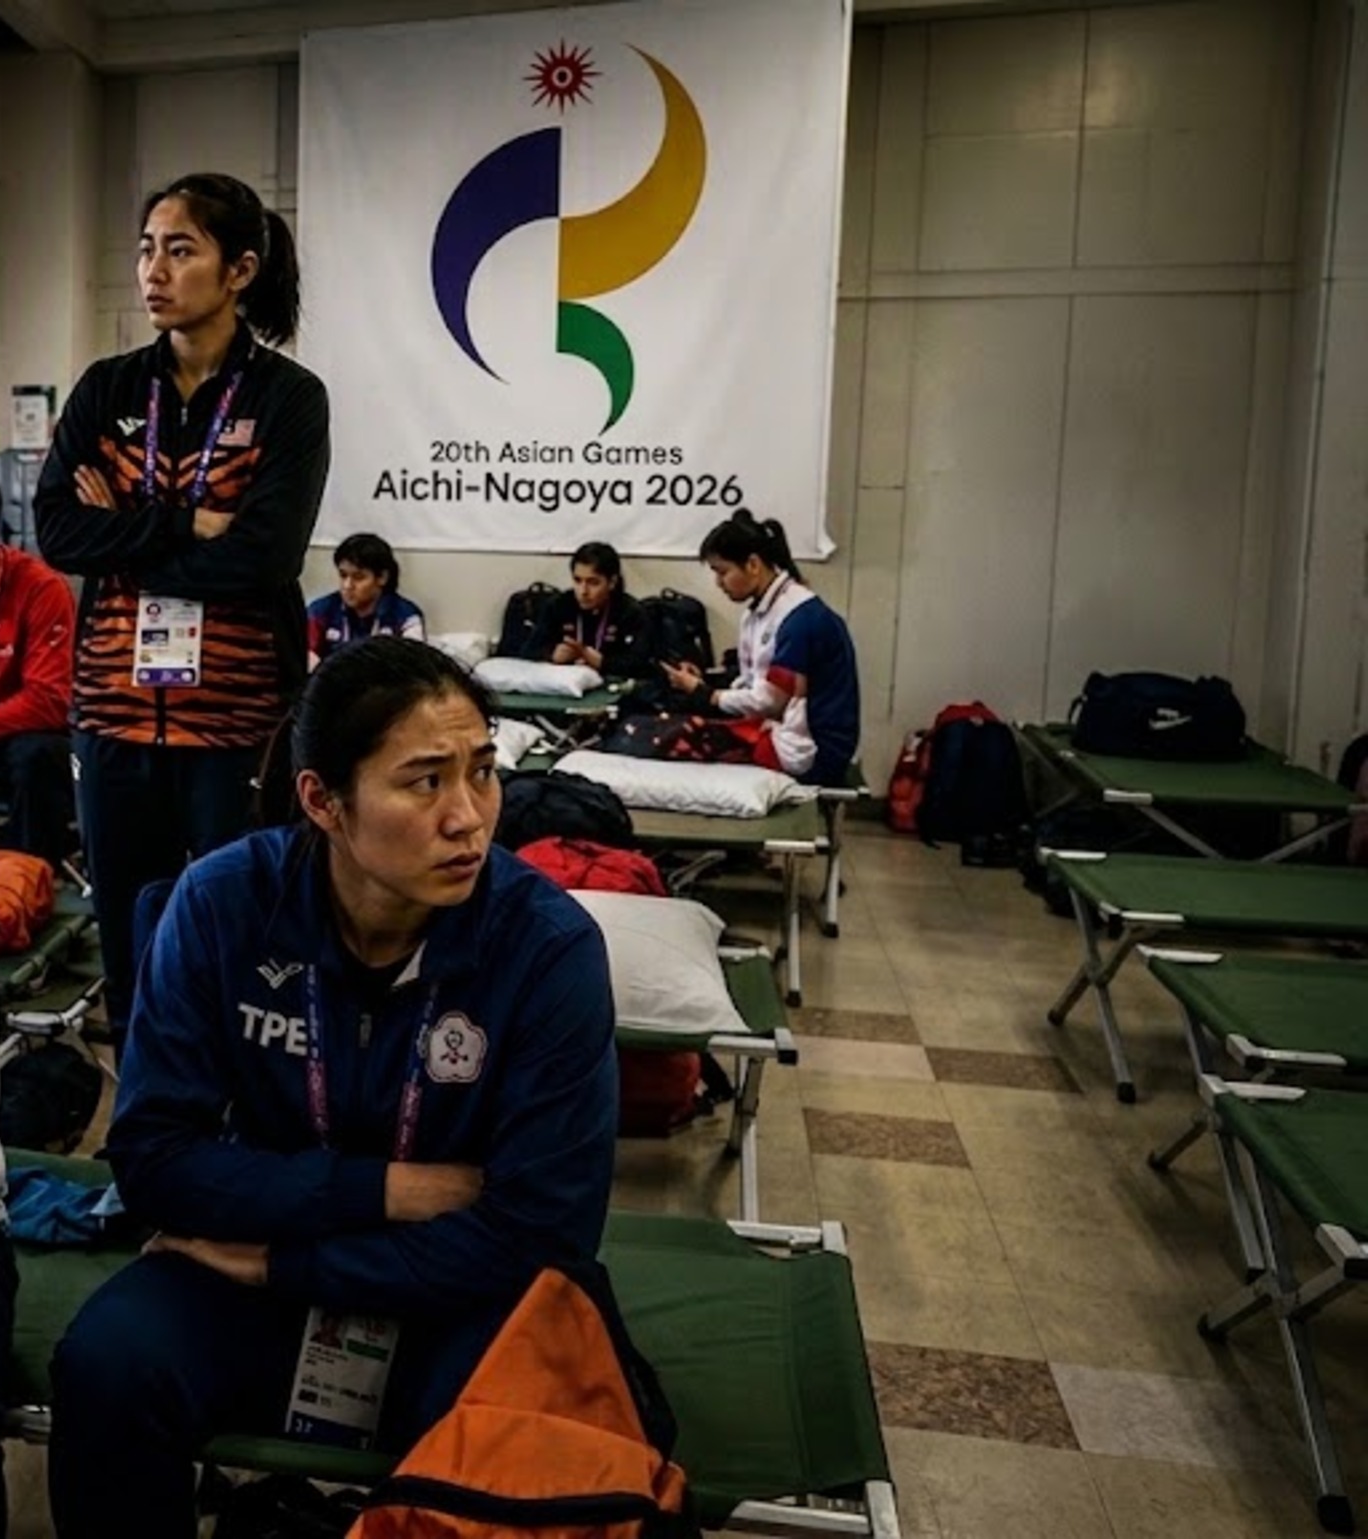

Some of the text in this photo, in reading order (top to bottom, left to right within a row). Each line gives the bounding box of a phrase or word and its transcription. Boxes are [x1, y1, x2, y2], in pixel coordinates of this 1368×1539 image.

[430, 440, 684, 465] 20th Asian Games
[372, 468, 744, 513] Aichi-Nagoya 2026
[237, 1001, 309, 1057] TPE
